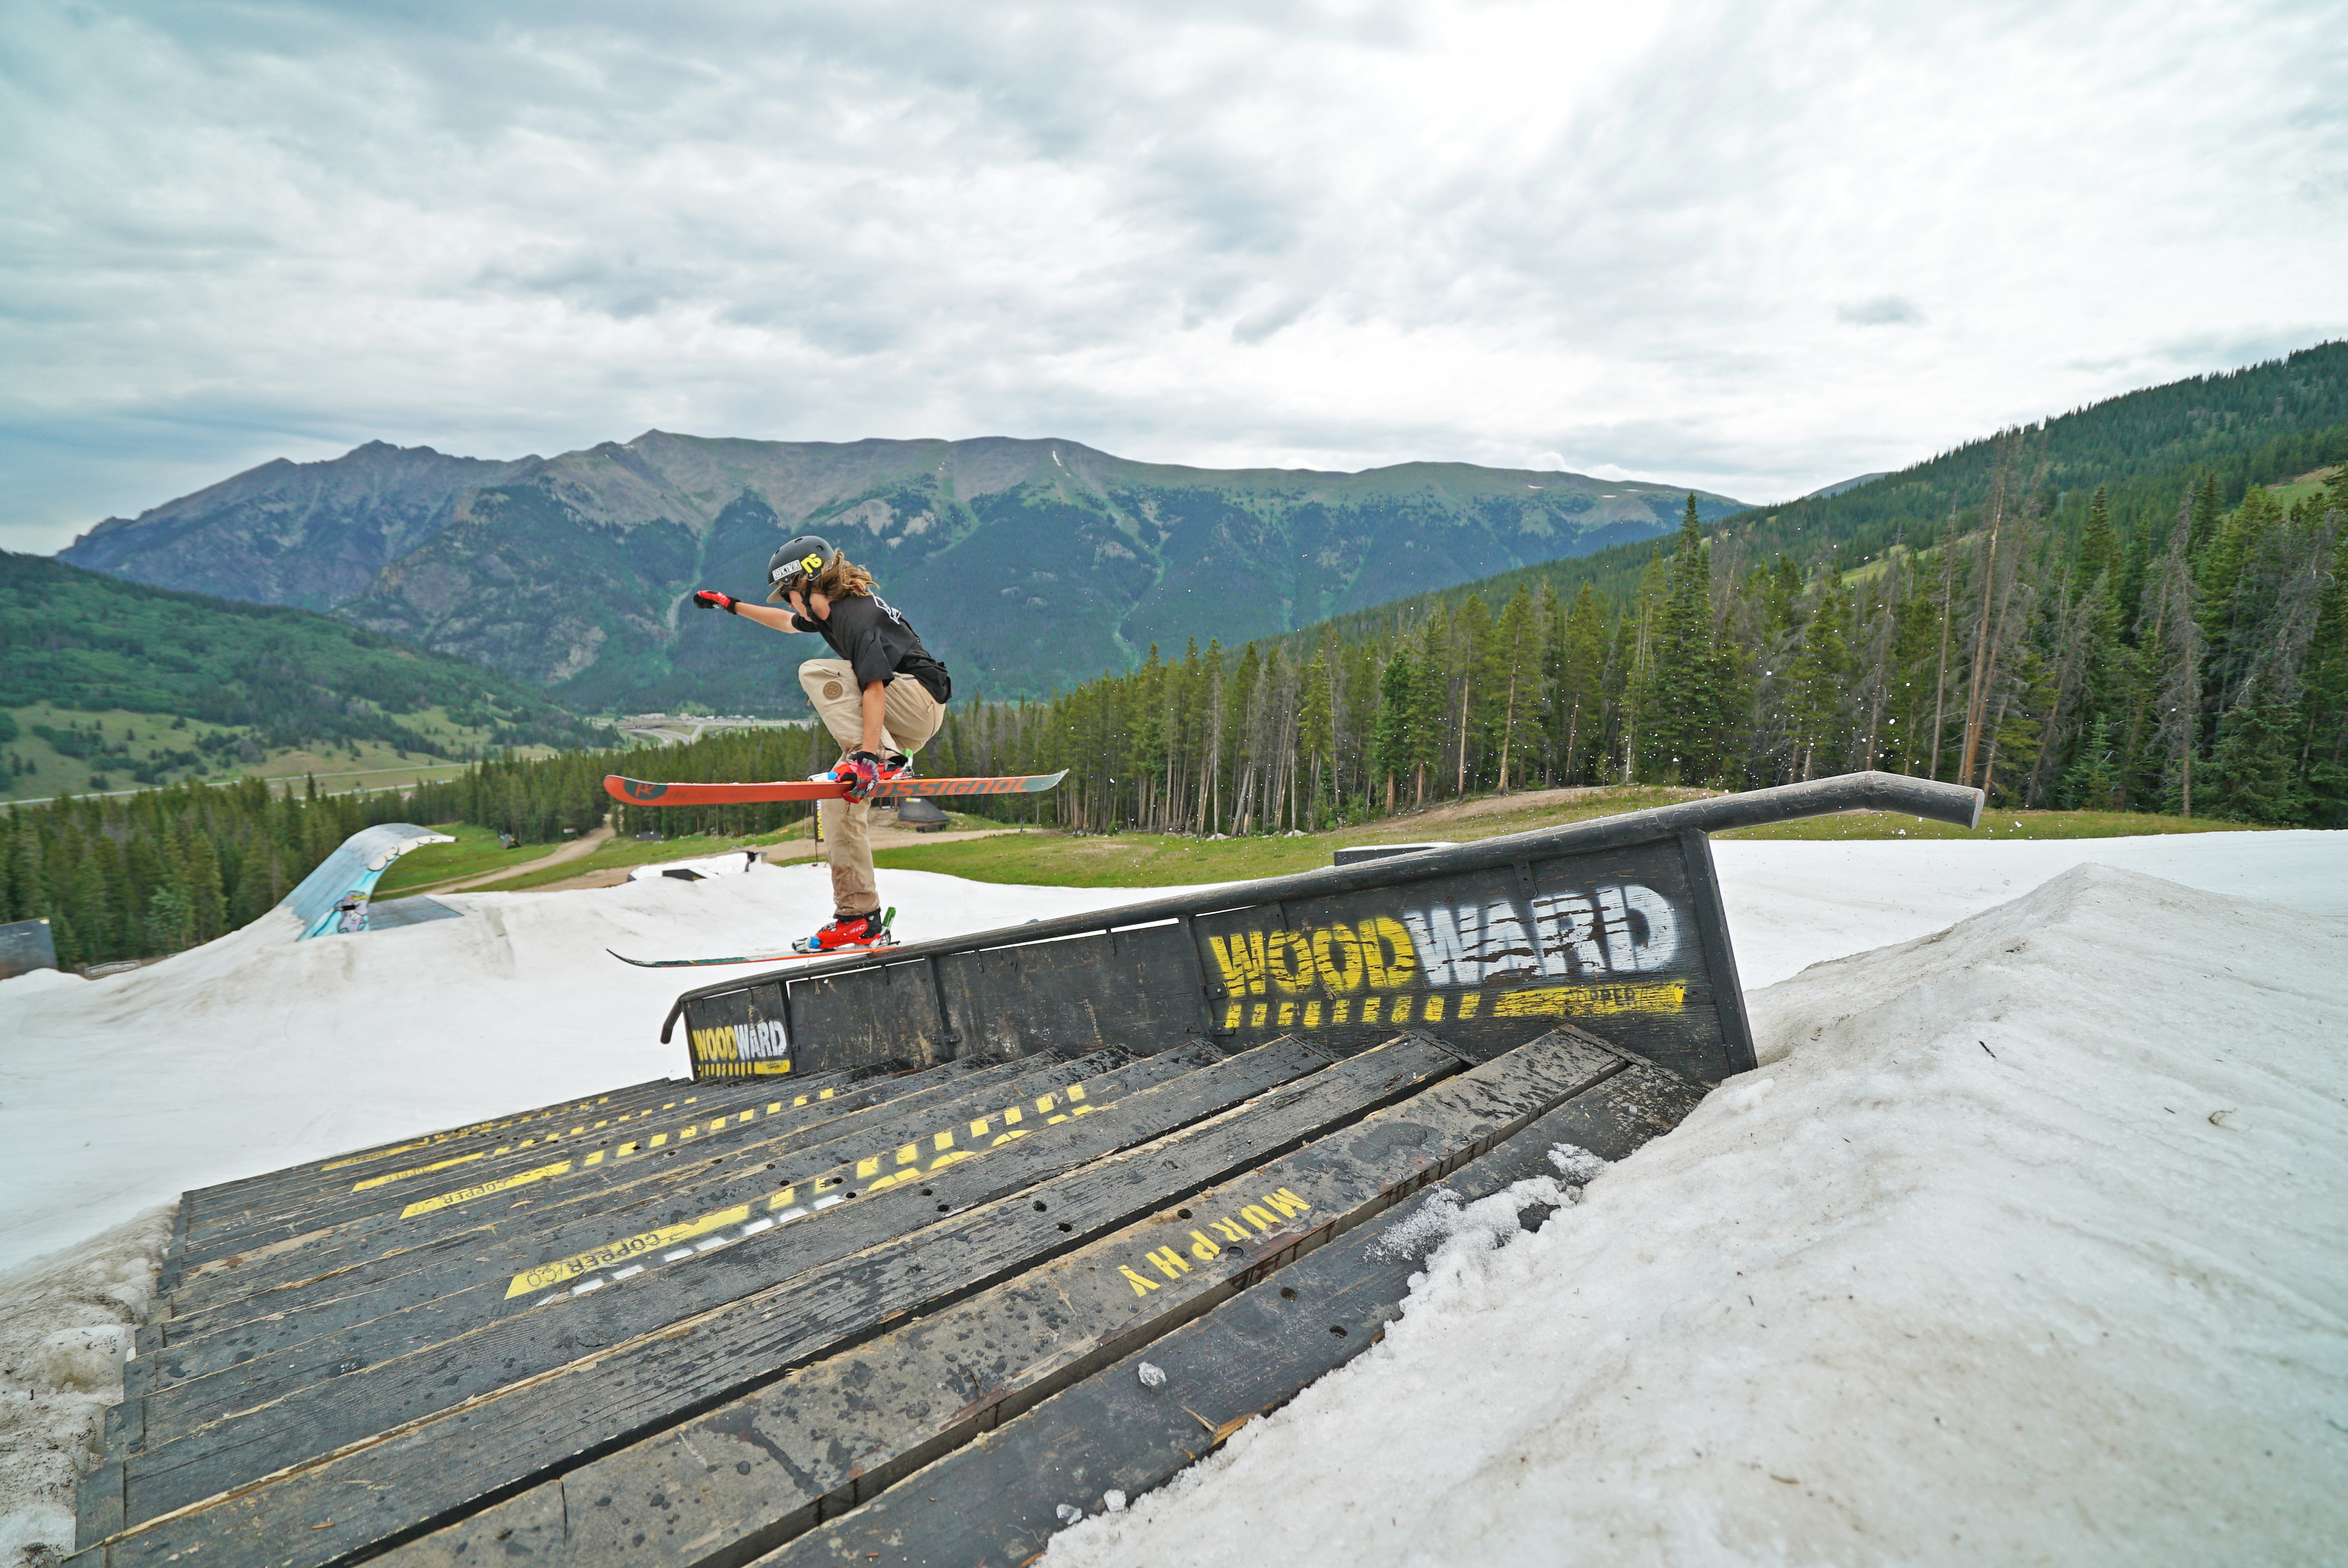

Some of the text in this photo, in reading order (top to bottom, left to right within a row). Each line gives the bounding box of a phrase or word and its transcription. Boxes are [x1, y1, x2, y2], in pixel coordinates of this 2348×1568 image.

[868, 778, 1028, 797] OSSIGNOL
[1209, 885, 1677, 997] WOODWARD
[692, 1020, 787, 1061] WOODWARD
[1118, 1188, 1311, 1297] MURPHY
